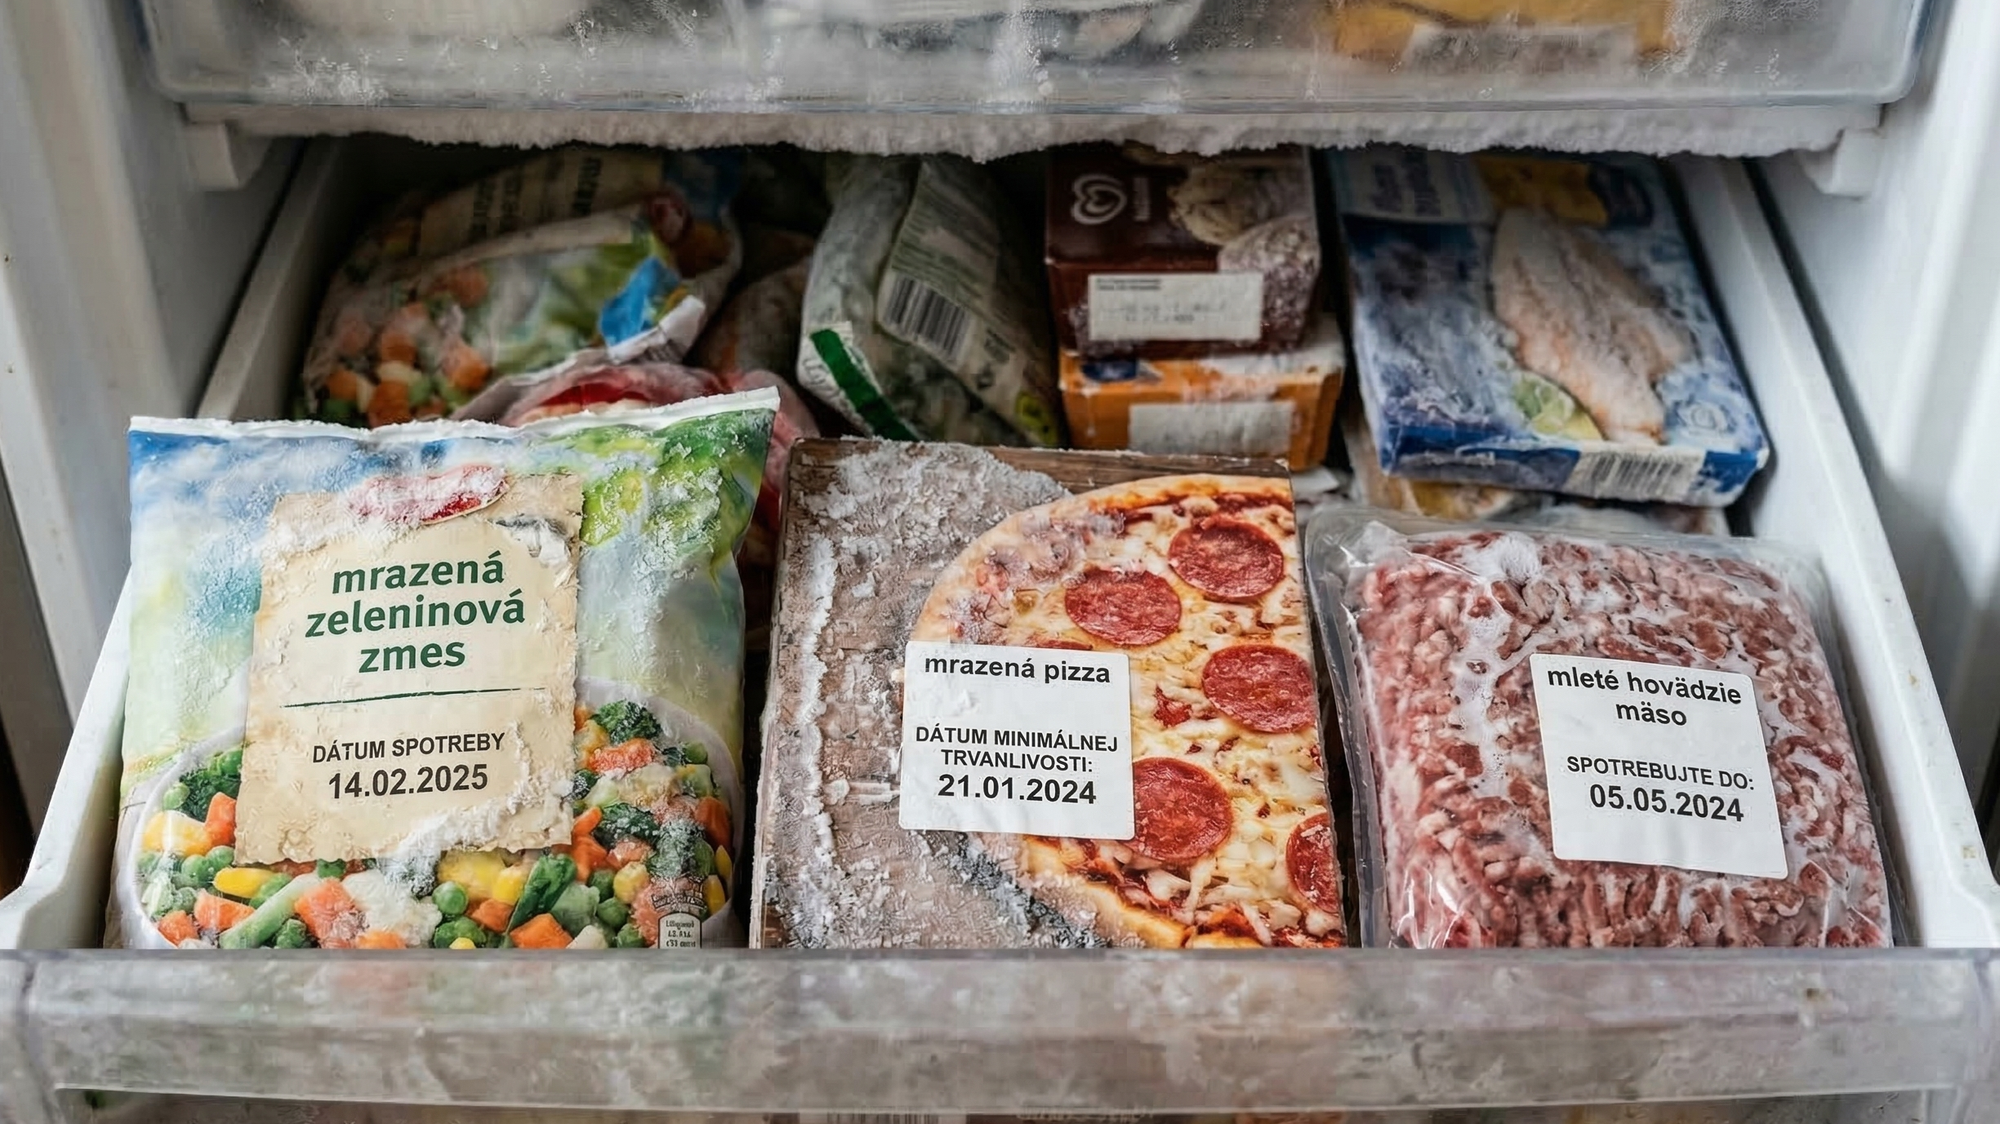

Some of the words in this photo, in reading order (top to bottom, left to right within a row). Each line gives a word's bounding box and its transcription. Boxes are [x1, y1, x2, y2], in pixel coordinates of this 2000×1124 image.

[332, 550, 505, 594] mrazená
[305, 588, 526, 638] zeleninová
[358, 641, 466, 674] zmes
[925, 657, 1035, 679] mrazená
[1044, 660, 1111, 684] pizza
[1547, 666, 1620, 691] mleté
[1626, 671, 1742, 706] hovädzie
[1615, 700, 1687, 726] mäso
[312, 739, 386, 764] DÁTUM
[391, 732, 506, 757] SPOTREBY
[916, 722, 987, 745] DÁTUM
[994, 729, 1118, 752] MINIMÁLNEJ
[940, 749, 1093, 773] TRVANLIVOSTI:
[1567, 755, 1714, 786] SPOTREBUJTE
[1718, 770, 1755, 791] DO:
[328, 763, 488, 799] 14.02.2025
[937, 773, 1097, 805] 21.01.2024
[1589, 783, 1745, 822] 05.05.2024
